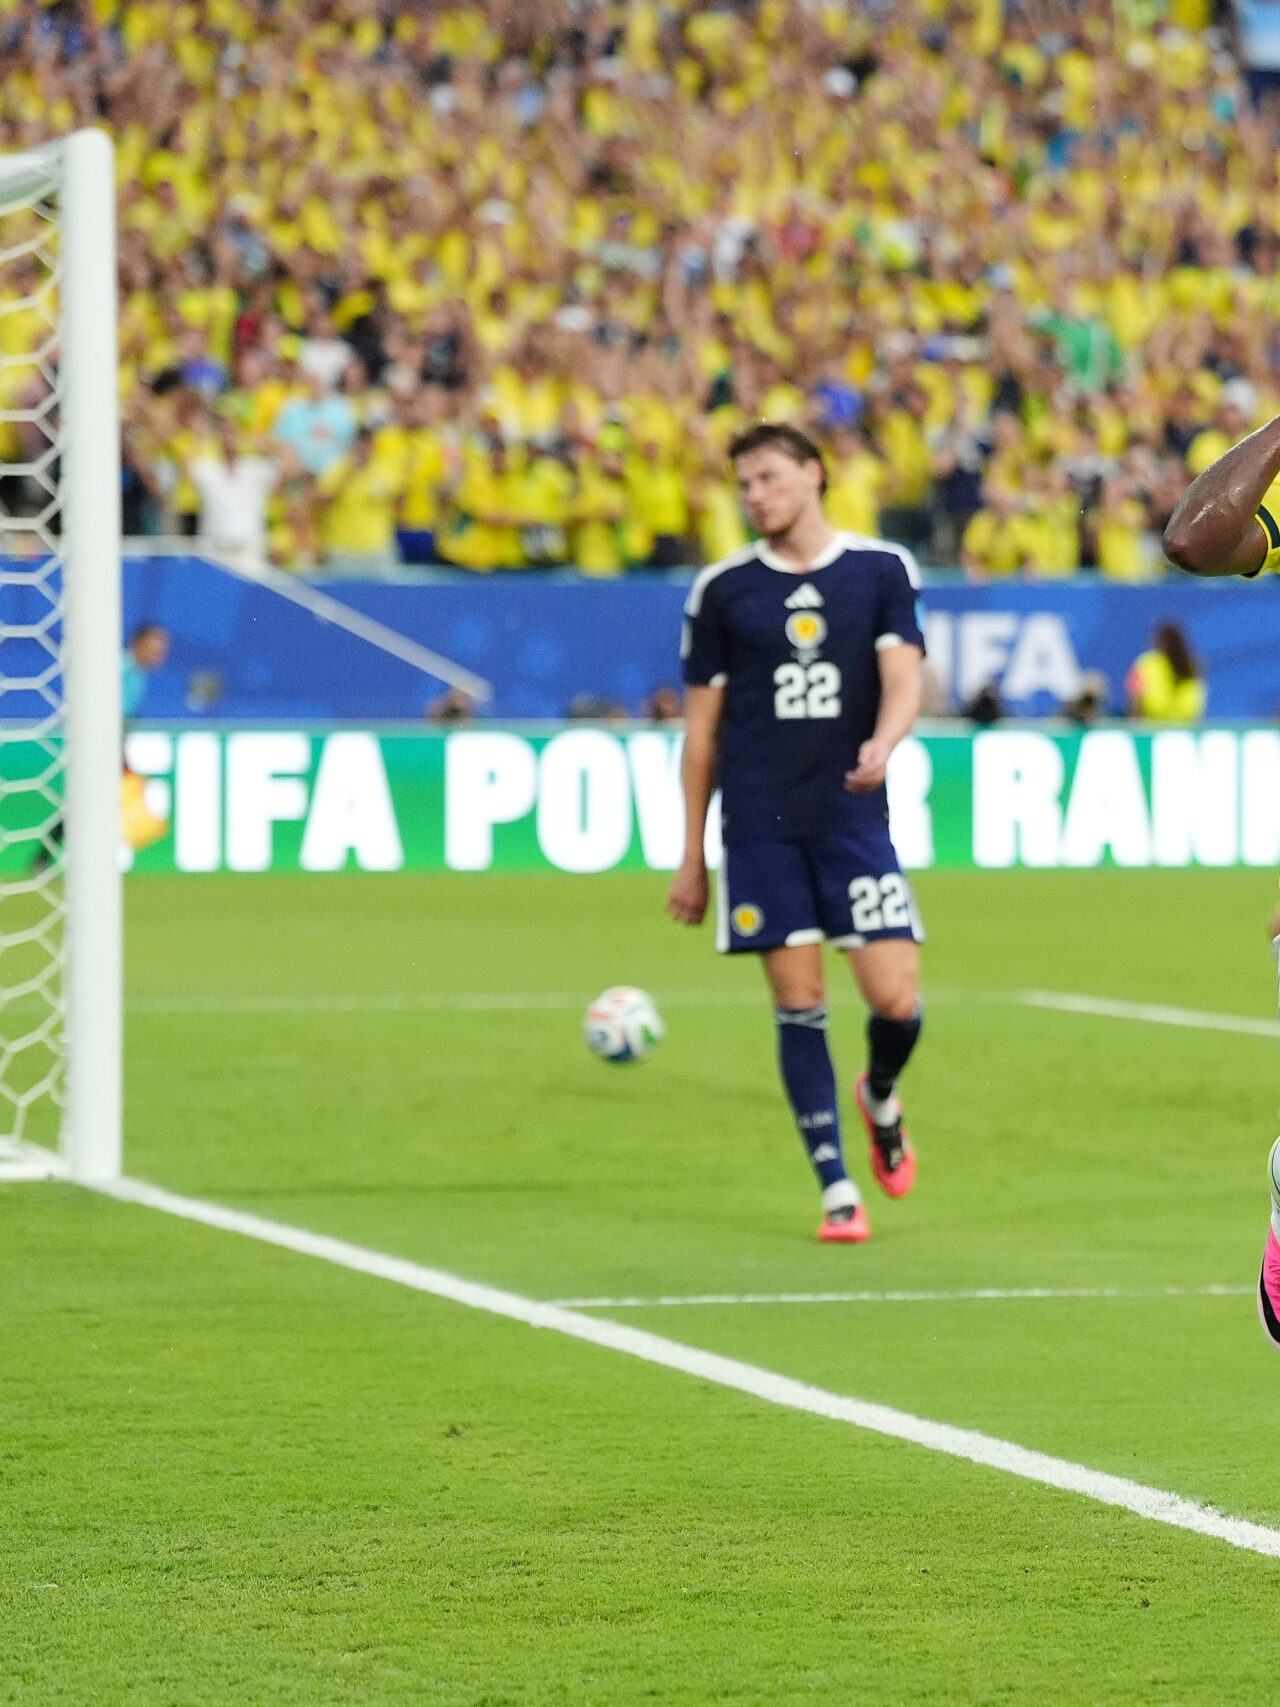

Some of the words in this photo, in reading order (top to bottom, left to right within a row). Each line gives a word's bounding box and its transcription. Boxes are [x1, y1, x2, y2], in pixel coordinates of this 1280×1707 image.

[925, 611, 1083, 702] IFA
[773, 661, 841, 719] 22
[848, 872, 911, 931] 22
